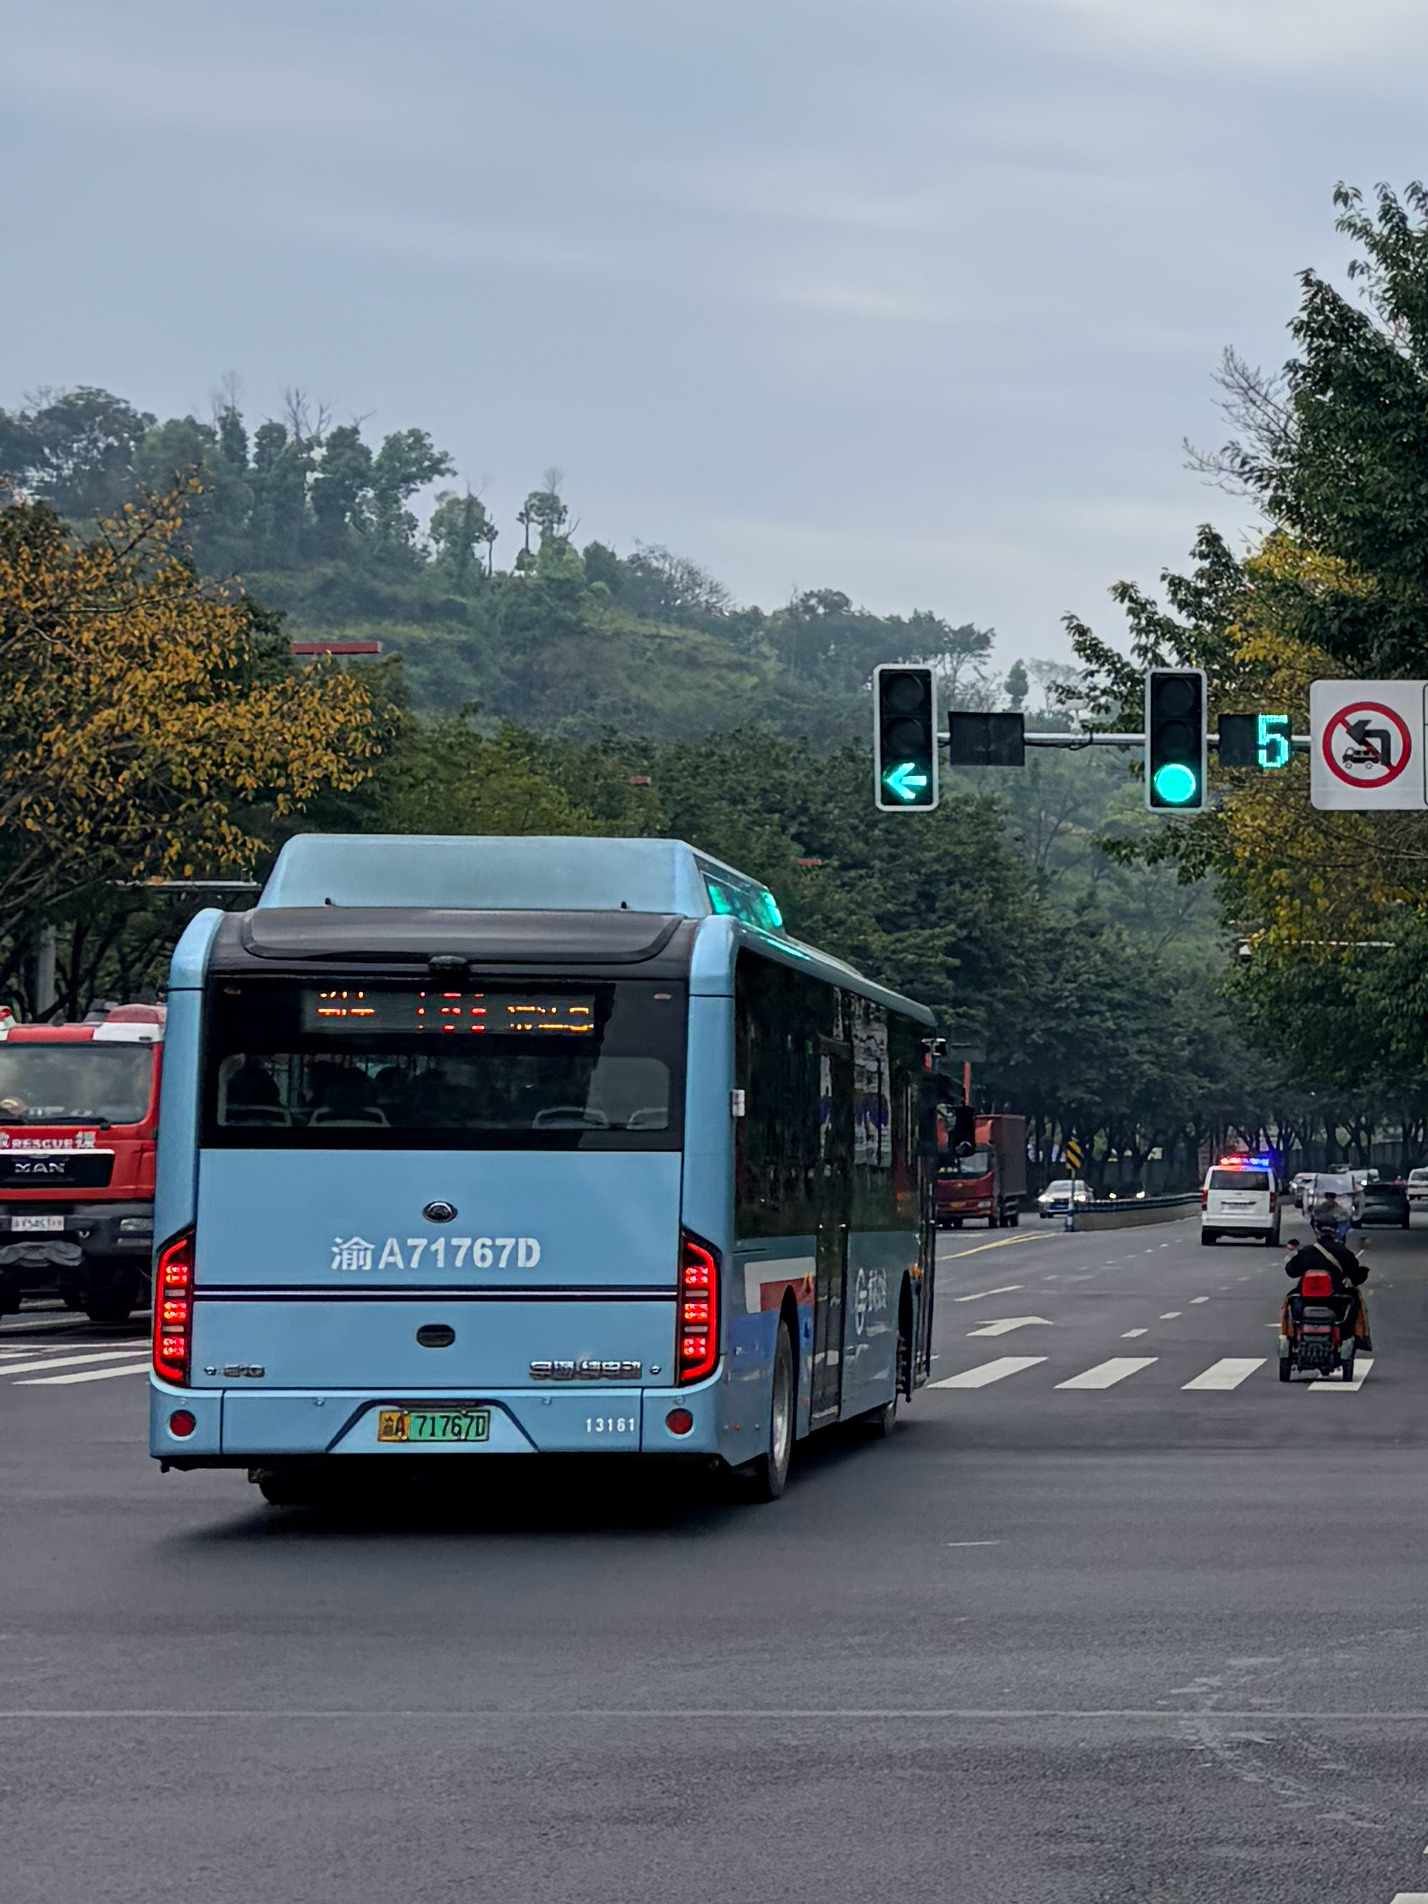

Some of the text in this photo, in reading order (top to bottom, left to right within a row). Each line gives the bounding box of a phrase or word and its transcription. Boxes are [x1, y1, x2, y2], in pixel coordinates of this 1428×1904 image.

[1257, 714, 1289, 769] 5
[11, 1138, 74, 1149] RESCUE
[14, 1162, 66, 1174] MAN
[331, 1236, 541, 1271] 渝A71767D
[585, 1417, 636, 1433] 13161
